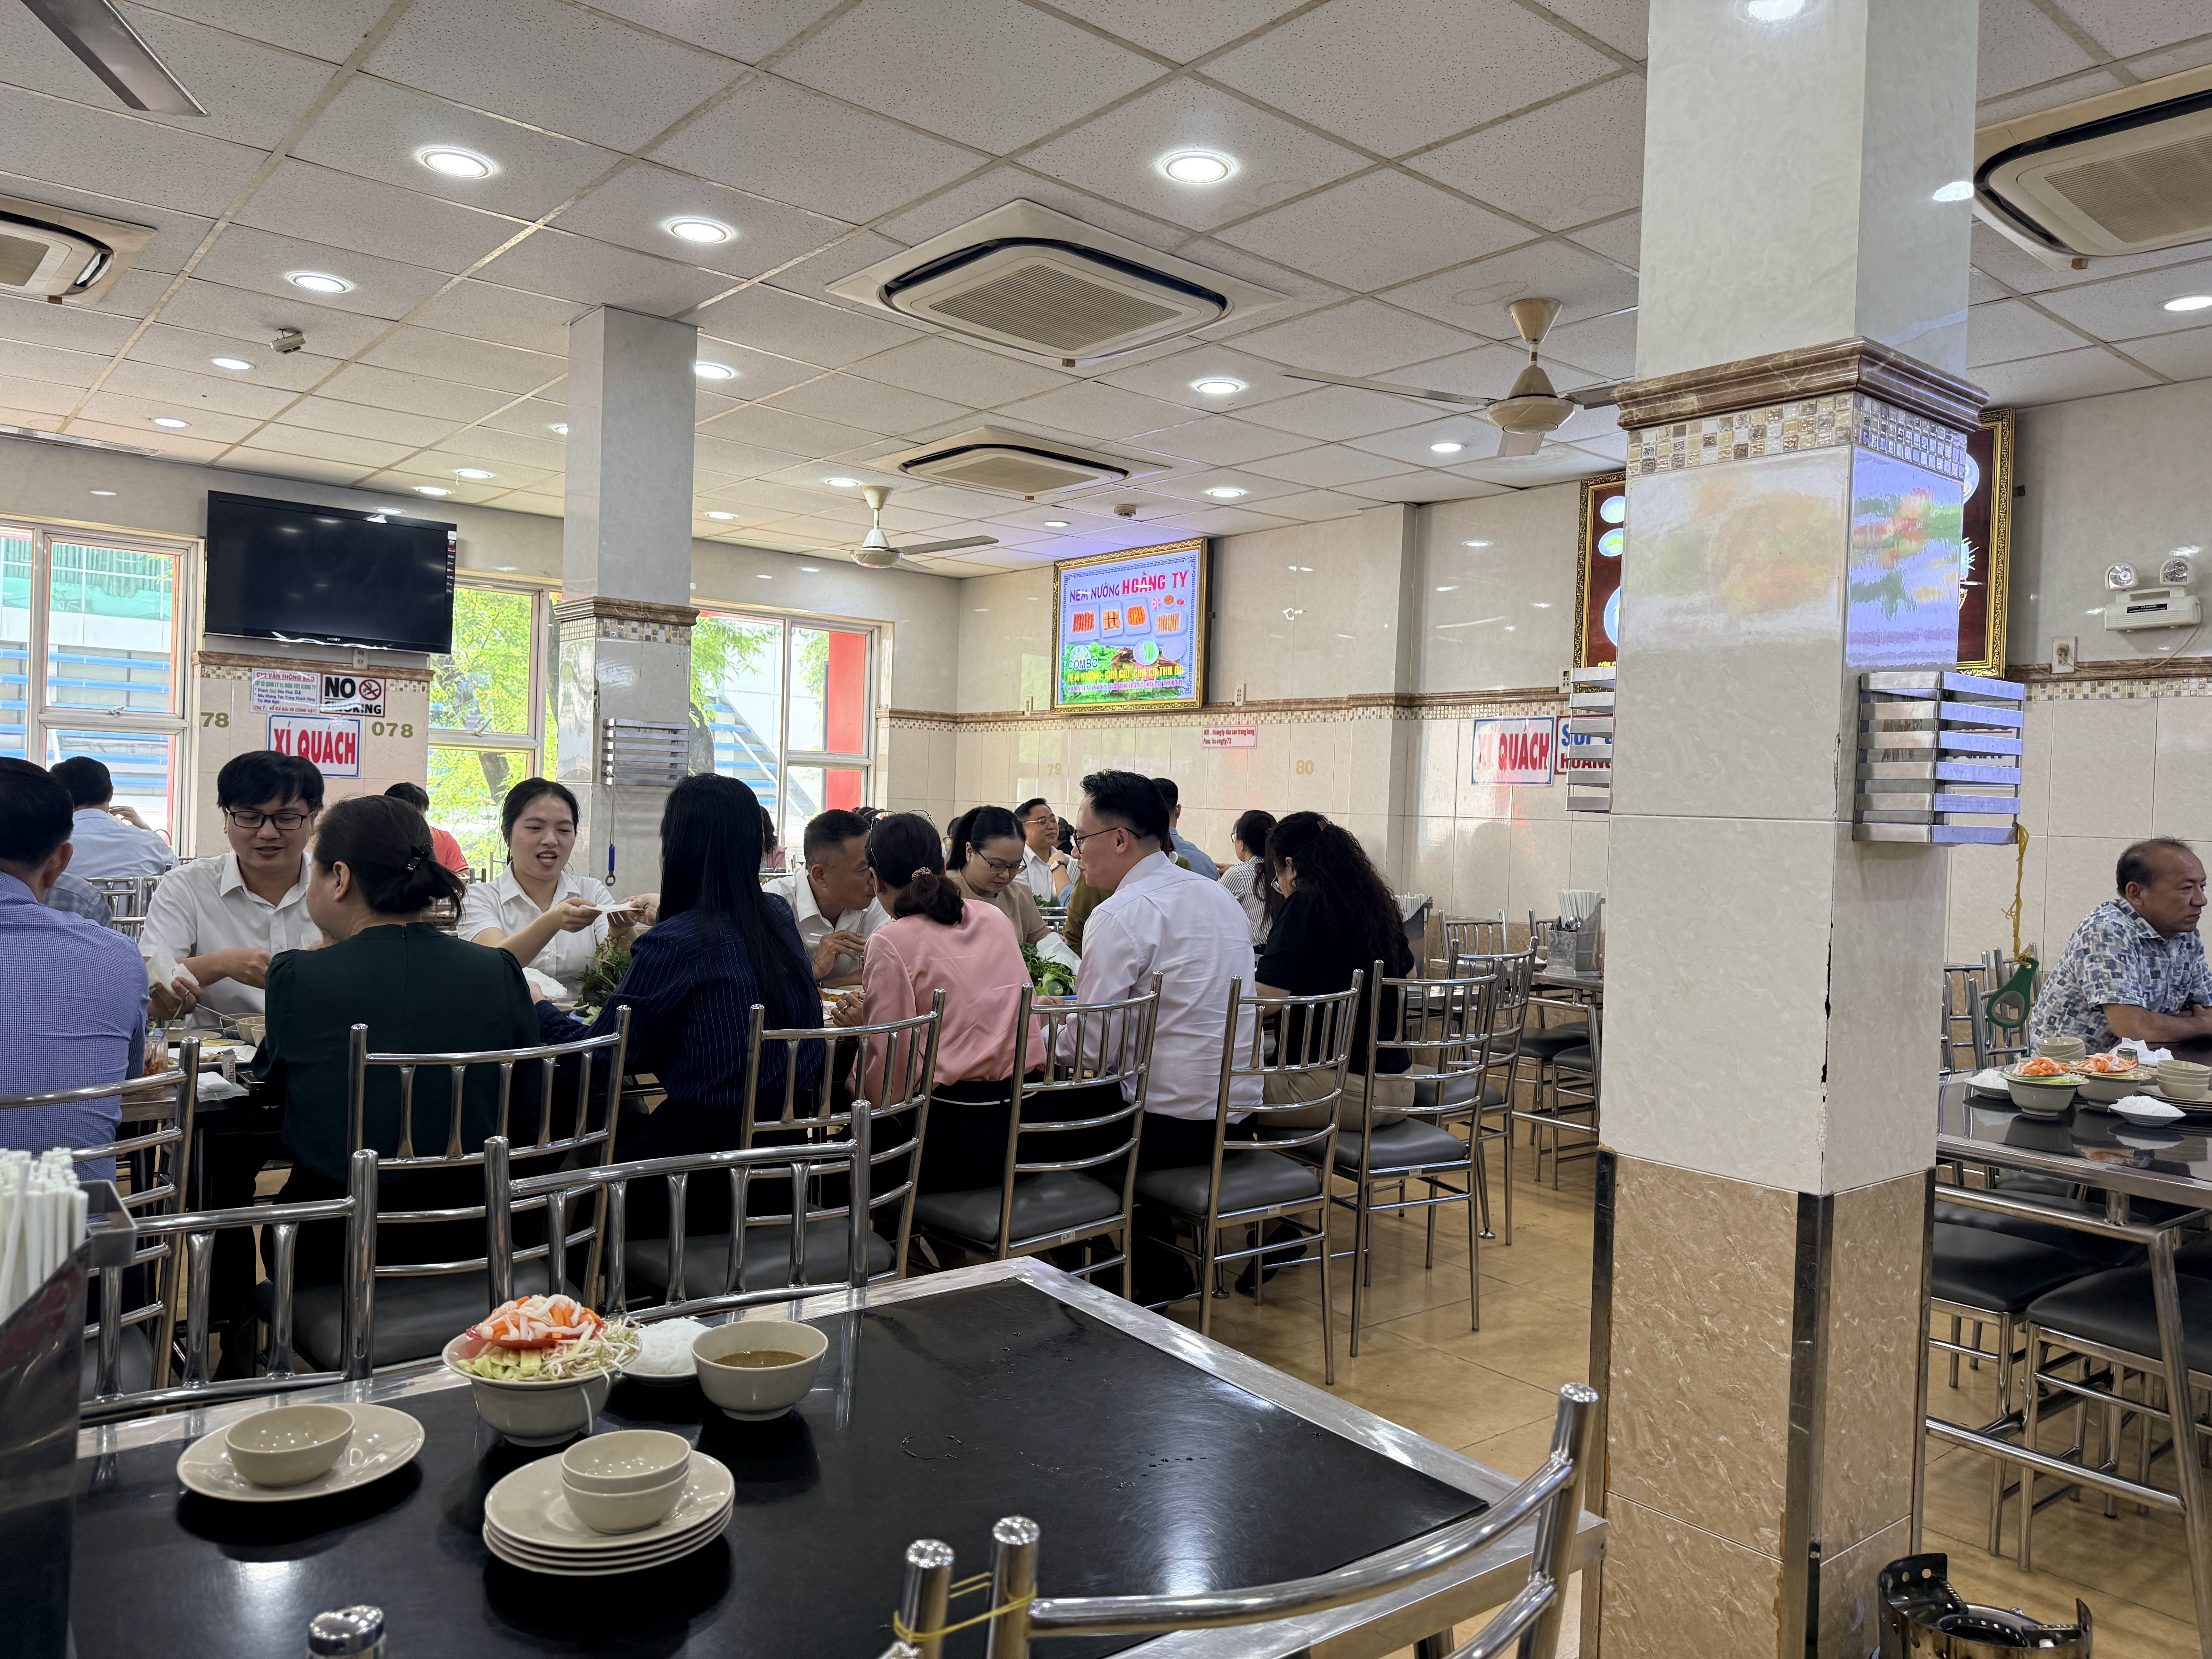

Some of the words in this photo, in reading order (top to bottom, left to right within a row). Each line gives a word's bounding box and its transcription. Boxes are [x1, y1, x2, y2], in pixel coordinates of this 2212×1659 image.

[1070, 588, 1088, 602] NEM
[1091, 582, 1120, 599] NƯỚNG
[1122, 571, 1166, 596] HOÀNG
[1171, 570, 1189, 589] TY
[1068, 658, 1097, 670] COMBO
[1159, 666, 1173, 676] THU
[325, 677, 356, 698] NO
[325, 701, 381, 714] KING
[201, 712, 229, 728] 78
[372, 721, 413, 738] 078
[274, 721, 291, 756] XÍ
[297, 723, 356, 764] QUÁCH
[1498, 725, 1549, 770] QUÁCH
[1047, 763, 1062, 776] 79
[1296, 760, 1314, 775] 80
